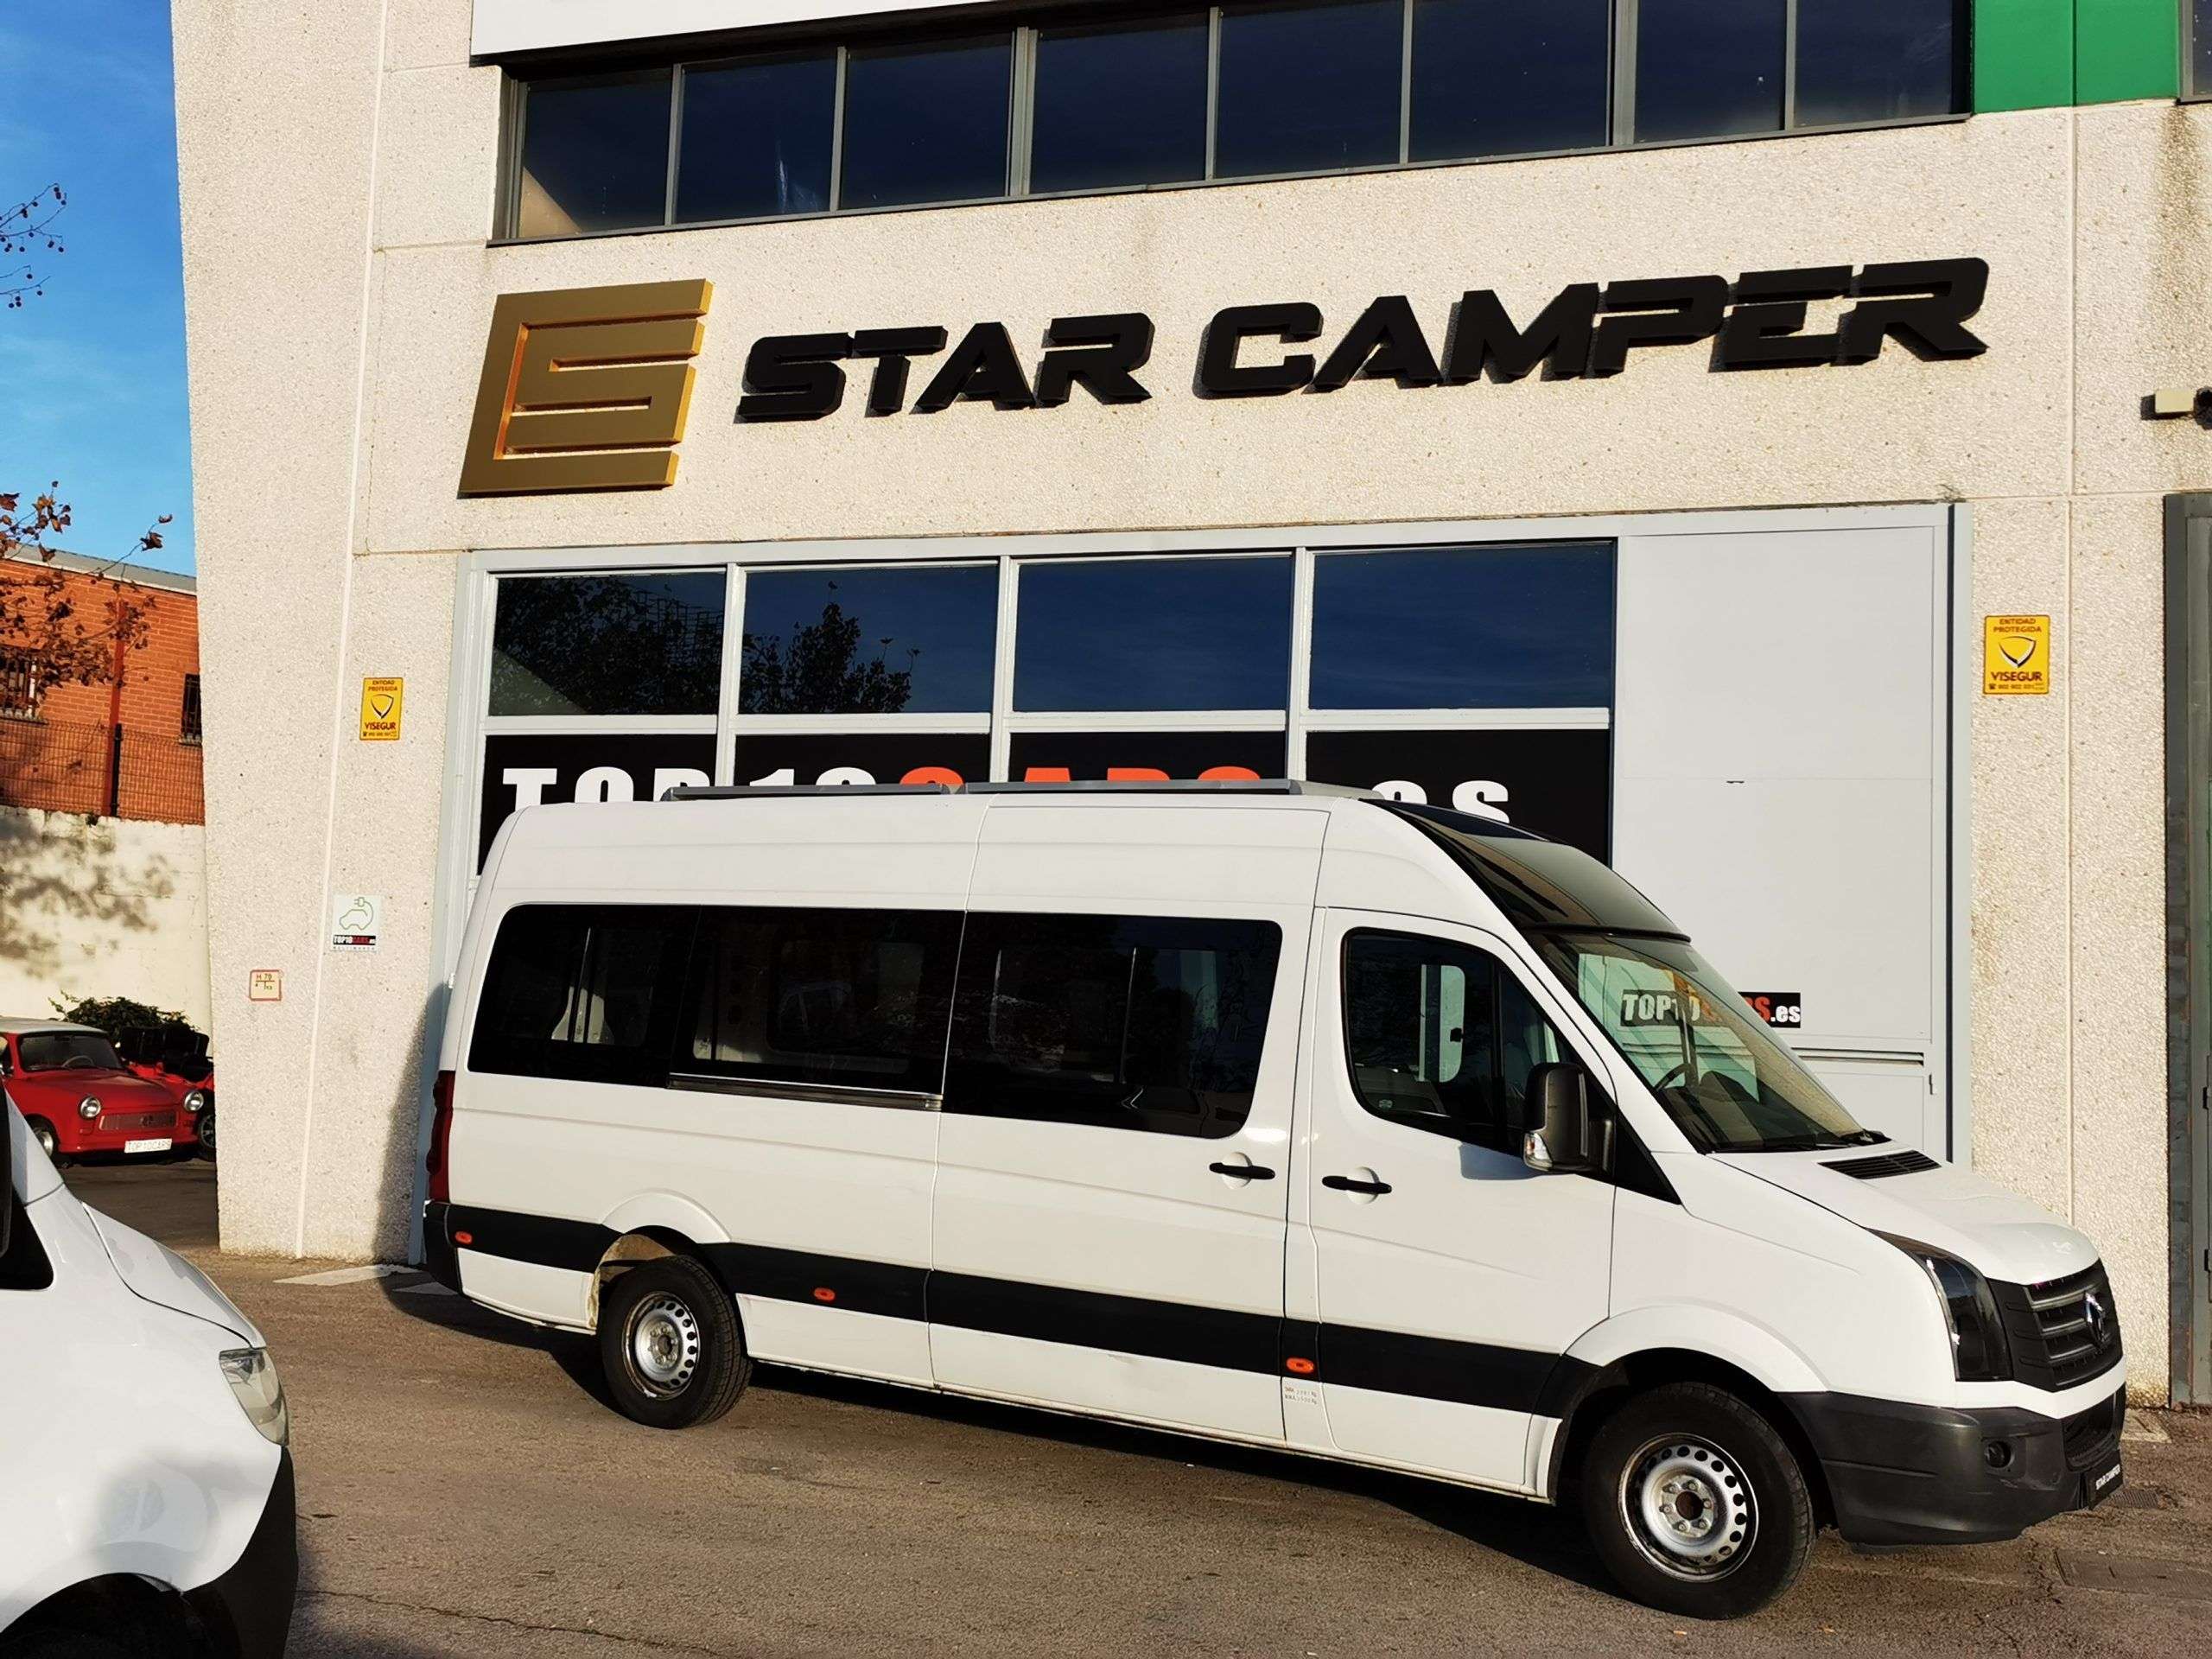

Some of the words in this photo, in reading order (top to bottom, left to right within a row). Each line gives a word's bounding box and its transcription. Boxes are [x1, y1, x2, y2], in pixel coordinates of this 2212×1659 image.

[739, 312, 1154, 423] STAR
[1193, 257, 1990, 399] CAMPER
[1991, 671, 2043, 682] VISEGUR
[365, 721, 397, 730] VISEGUR
